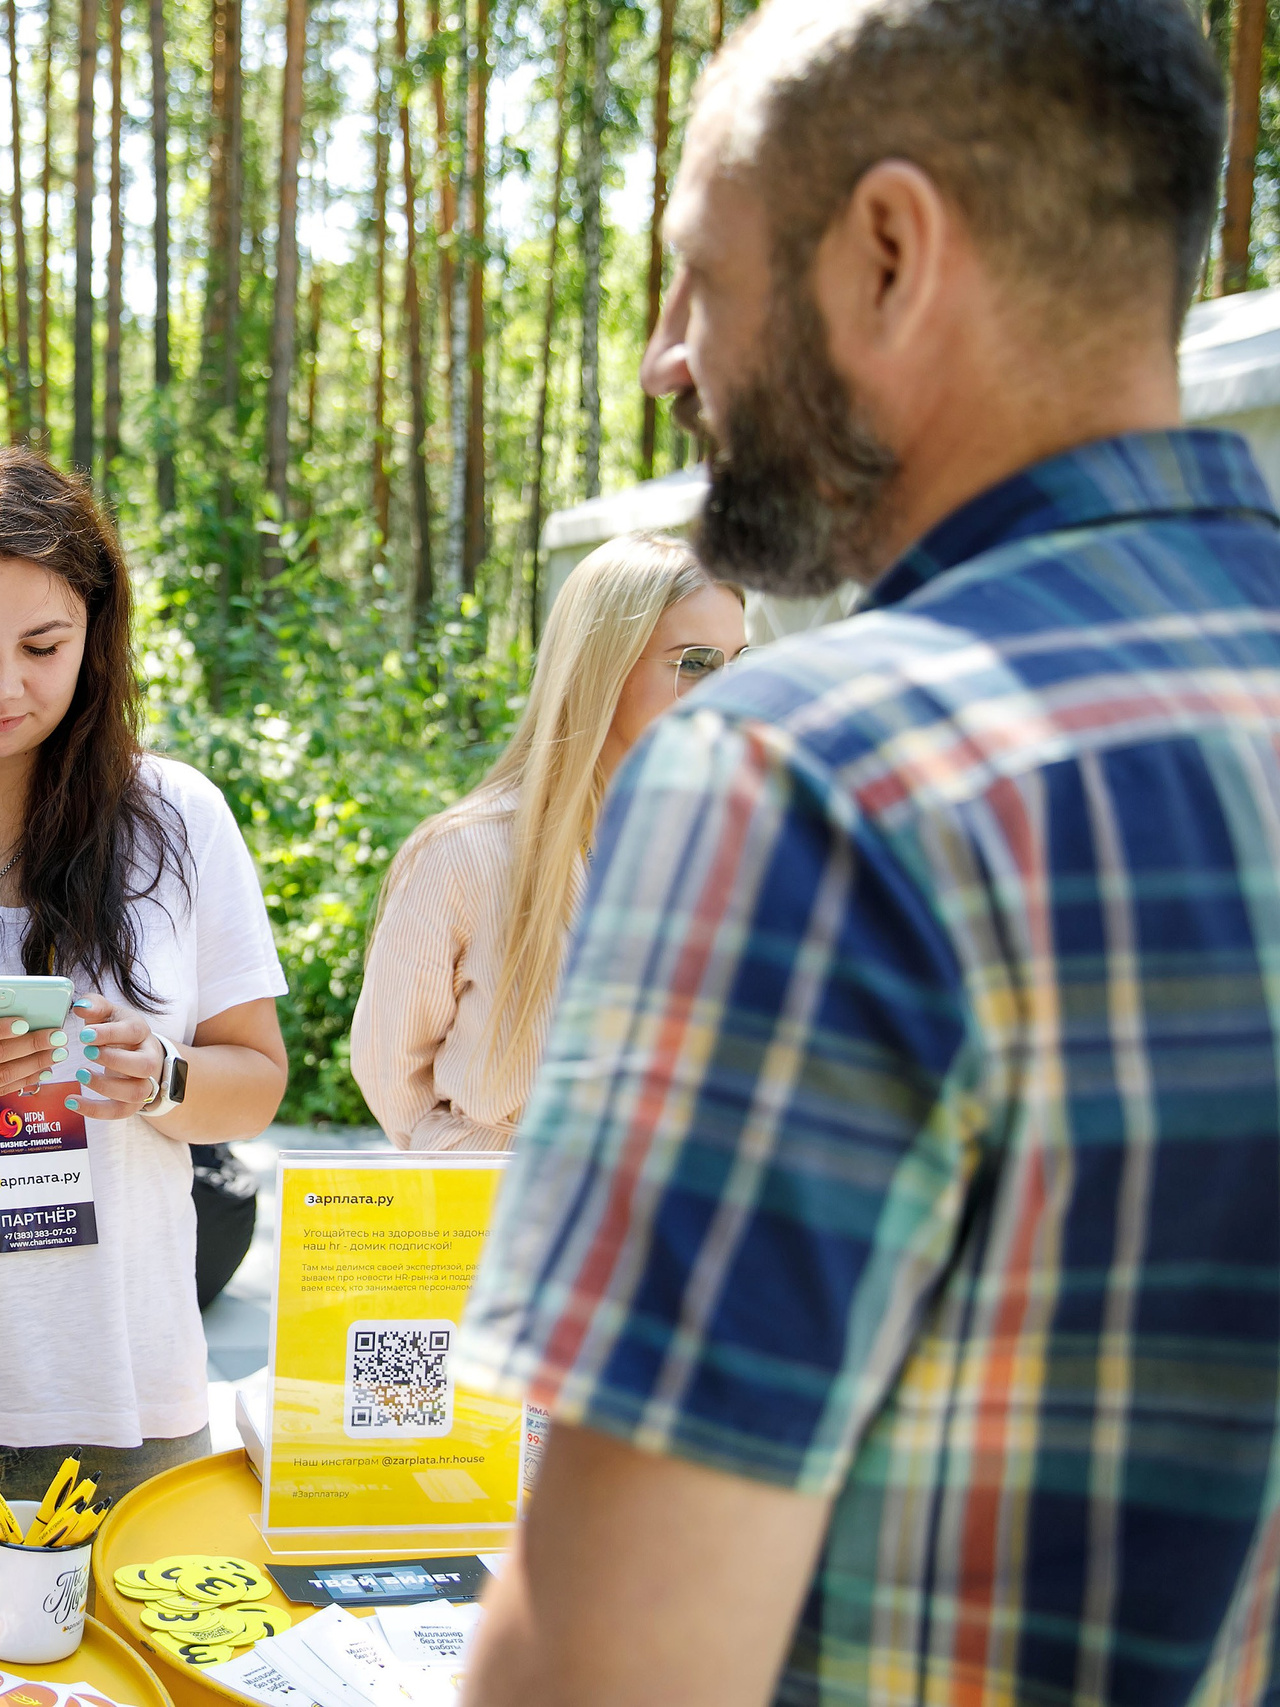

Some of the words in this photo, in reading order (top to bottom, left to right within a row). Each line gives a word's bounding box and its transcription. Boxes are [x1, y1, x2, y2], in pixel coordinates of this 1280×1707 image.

[0, 1137, 62, 1149] БИЗНЕС-ПИКНИК
[307, 1195, 394, 1207] зарплата.ру
[1, 1206, 77, 1228] ПАРТНЁР
[13, 1230, 34, 1241] (383)
[34, 1227, 77, 1239] 383-07-03
[303, 1228, 369, 1238] Угощайтесь
[388, 1229, 440, 1239] здоровье
[452, 1230, 494, 1238] задона
[9, 1236, 73, 1249] www.charisma.ru
[303, 1242, 326, 1251] наш
[328, 1241, 340, 1250] hr
[349, 1243, 386, 1251] домик
[389, 1241, 453, 1251] подпиской!
[302, 1263, 319, 1271] Там
[336, 1264, 375, 1272] делимся
[377, 1263, 404, 1271] своей
[405, 1263, 464, 1272] экспертизой,
[465, 1264, 480, 1272] рас
[301, 1274, 335, 1282] зываем
[337, 1274, 354, 1282] про
[394, 1273, 439, 1282] HR-рынка
[325, 1285, 347, 1293] всех,
[293, 1458, 318, 1467] Наш
[321, 1457, 379, 1467] инстаграм
[381, 1455, 485, 1467] @zarplata.hr.house
[292, 1490, 350, 1499] #Зарплатару
[308, 1575, 378, 1590] ТВОЙ
[382, 1572, 461, 1588] БИЛЕТ
